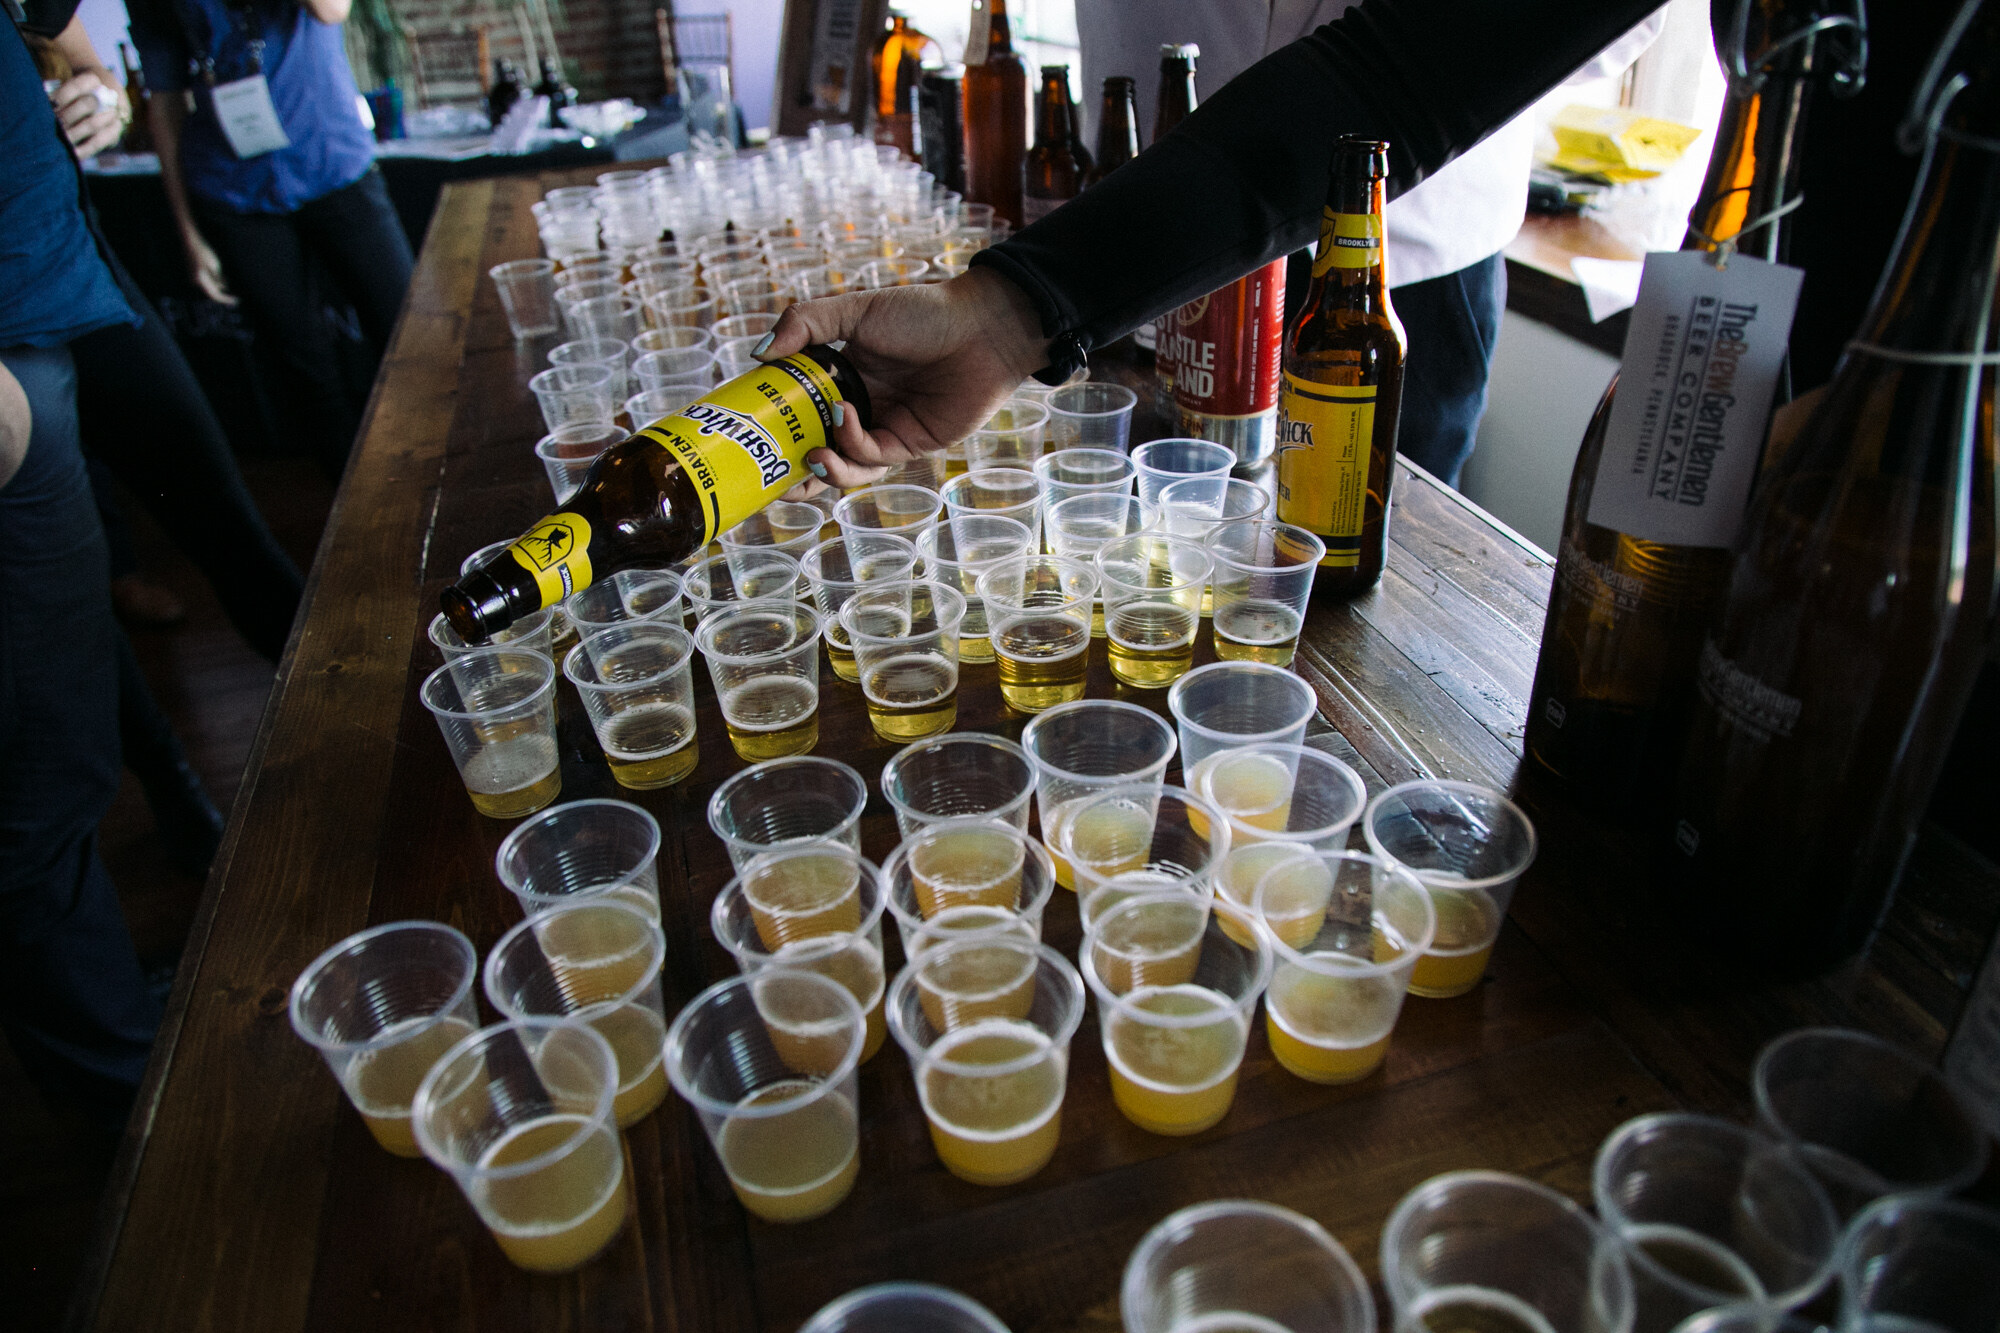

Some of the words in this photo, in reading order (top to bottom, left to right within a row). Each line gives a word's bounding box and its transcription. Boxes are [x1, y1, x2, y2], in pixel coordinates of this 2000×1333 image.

[1687, 296, 1715, 355] BEER
[788, 367, 817, 394] CRAFTY
[814, 394, 822, 402] &
[757, 381, 805, 444] PILSNER
[819, 403, 832, 427] BOLD
[1656, 372, 1698, 500] COMPANY
[670, 435, 715, 490] BRAVEN
